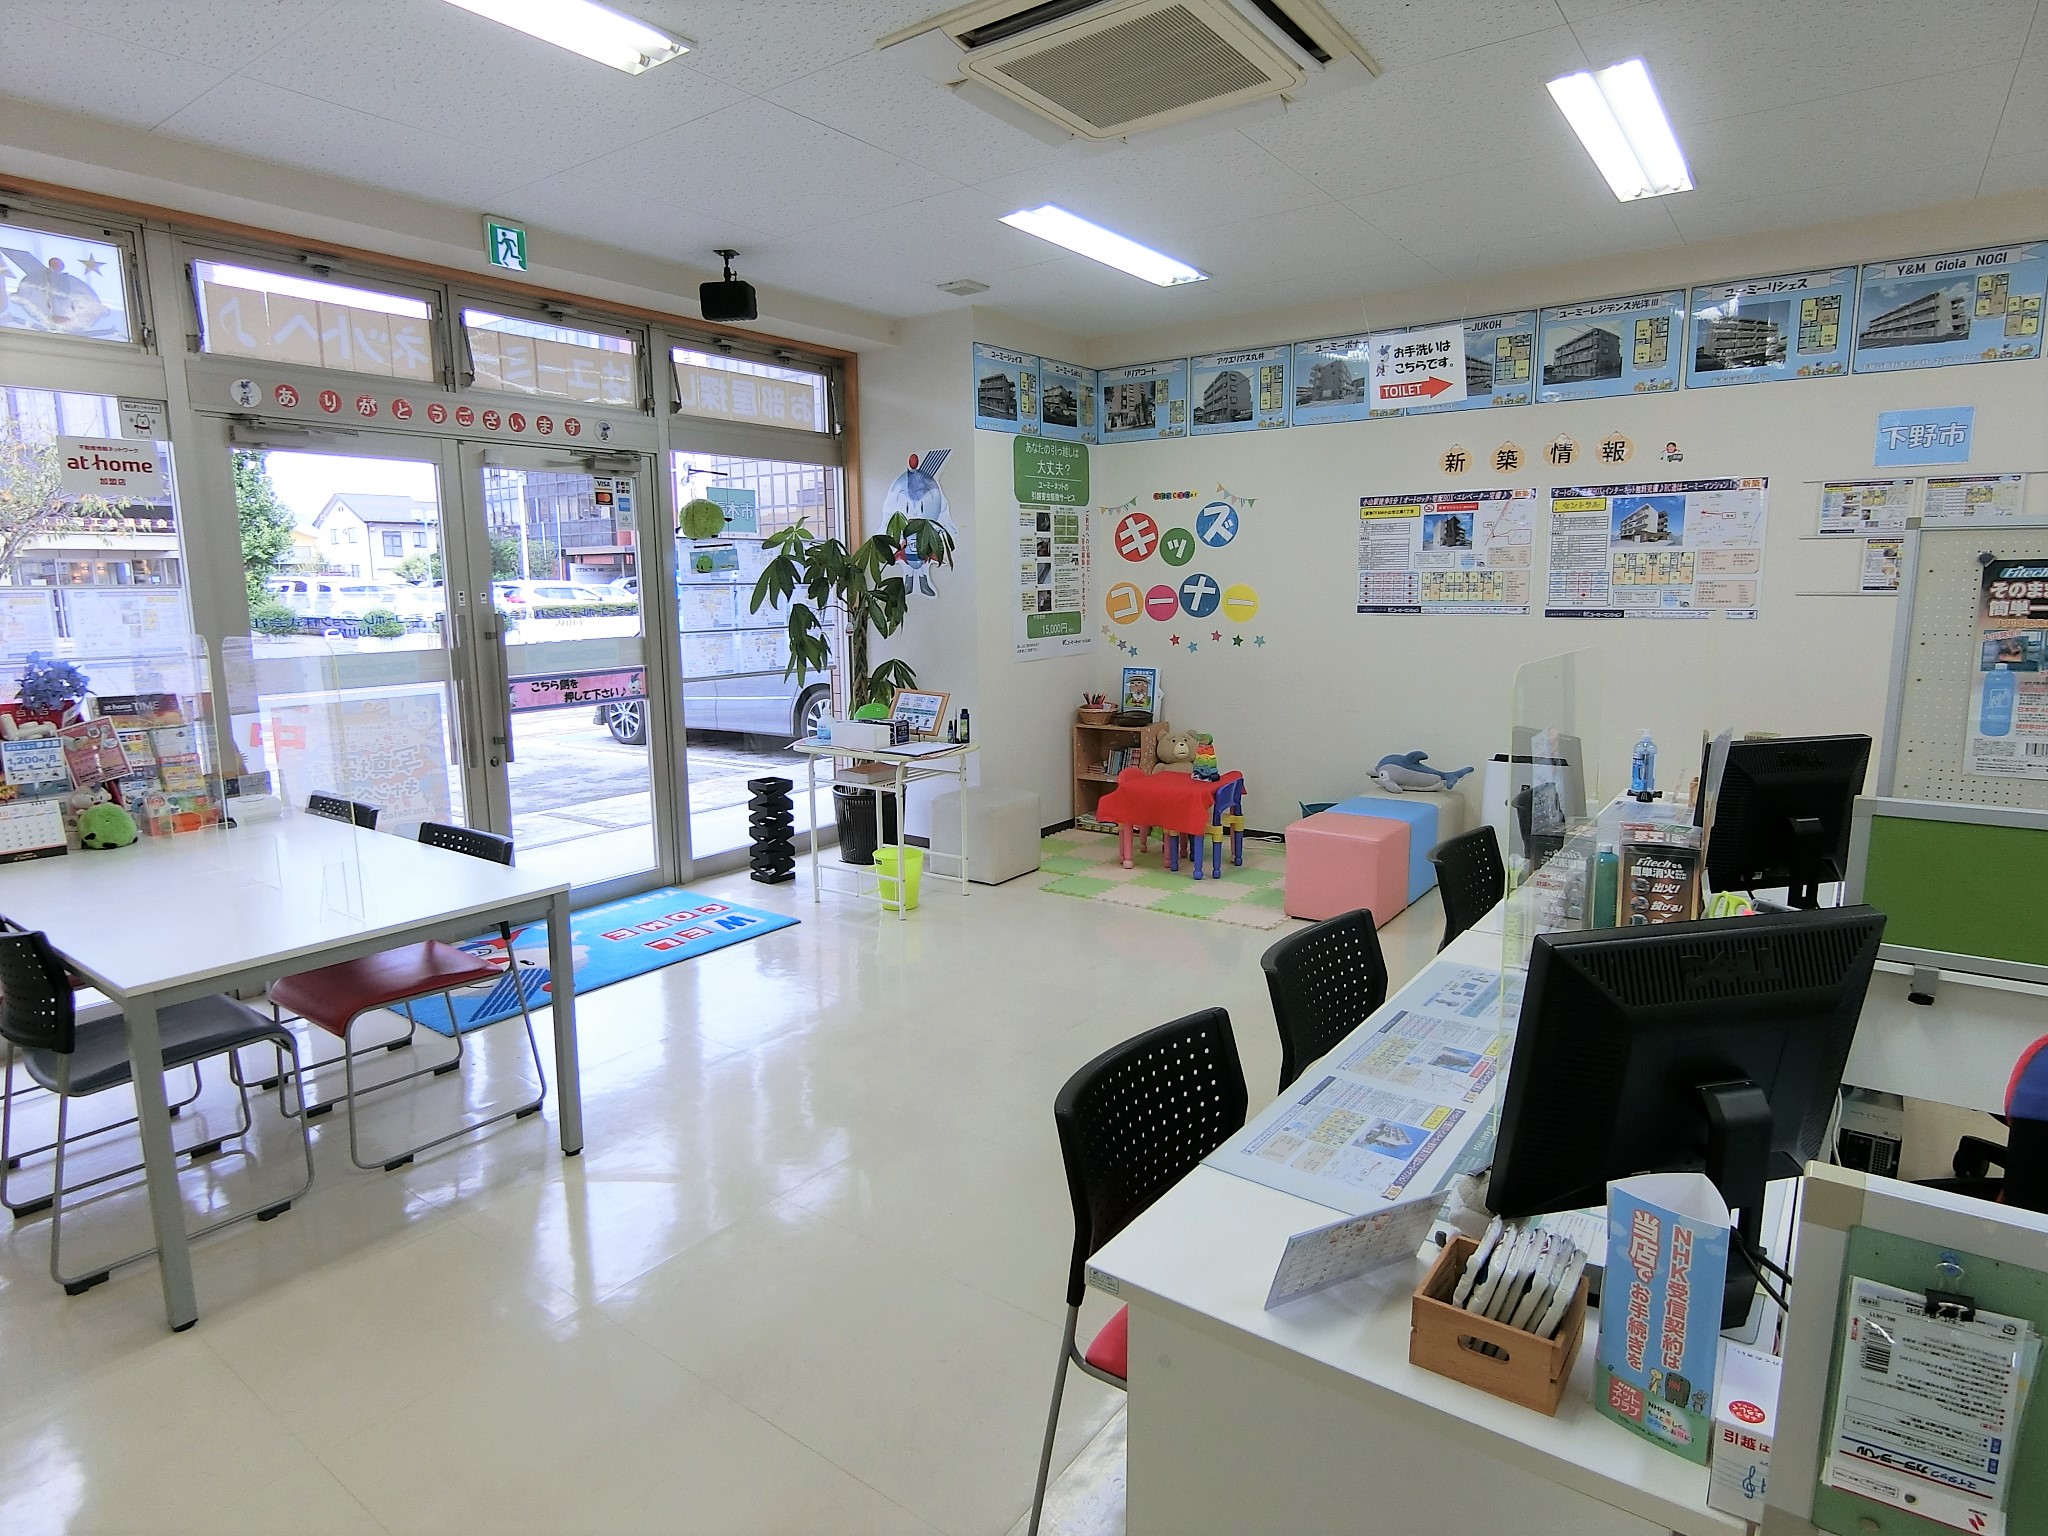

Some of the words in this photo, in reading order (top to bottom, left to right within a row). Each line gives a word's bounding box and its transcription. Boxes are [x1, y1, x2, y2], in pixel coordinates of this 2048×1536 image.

[1897, 264, 1926, 276] Y&M
[1935, 259, 1966, 271] Gioia
[1976, 252, 2008, 266] NOGI
[1724, 278, 1808, 298] ユーミーリシェス
[1394, 340, 1451, 359] お手洗いは
[1394, 358, 1454, 374] こちらです。
[1383, 383, 1422, 397] TOILET
[278, 384, 581, 437] ありがとうございます
[1880, 422, 1968, 450] 下野市
[1025, 442, 1080, 458] あなたの引っ越しは
[1445, 440, 1626, 473] 新築情報
[67, 456, 89, 470] at
[92, 454, 153, 473] home
[1037, 459, 1071, 476] 大丈夫?
[1119, 504, 1234, 559] キッズ
[1110, 576, 1255, 619] コーナー
[1989, 582, 2048, 598] そのま
[531, 680, 579, 692] こちら側を
[112, 703, 132, 711] home
[133, 702, 160, 711] TIME
[1651, 883, 1681, 894] 出火!
[602, 904, 727, 940] COME
[648, 915, 757, 949] WEL
[1626, 1209, 1661, 1372] 当店でお手続きを
[1661, 1224, 1694, 1371] NHK受信契約は
[1612, 1385, 1640, 1405] ネット
[1618, 1382, 1637, 1394] NHK
[1611, 1396, 1640, 1416] クラブ
[1856, 1445, 1929, 1475] カラーラベル
